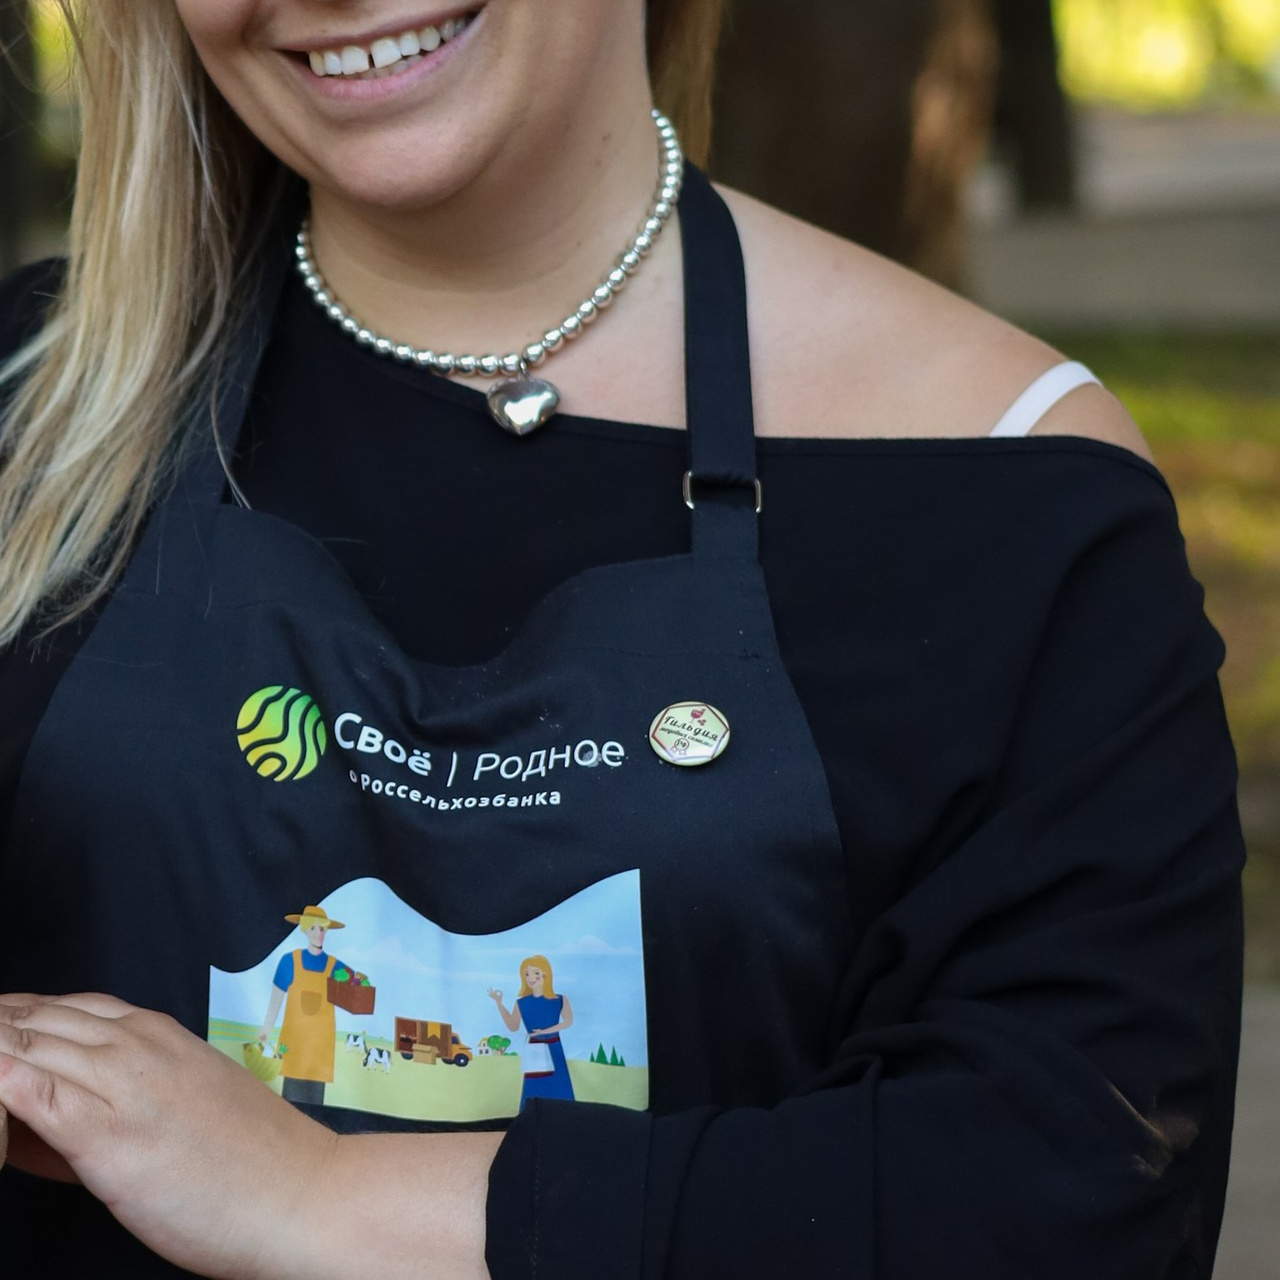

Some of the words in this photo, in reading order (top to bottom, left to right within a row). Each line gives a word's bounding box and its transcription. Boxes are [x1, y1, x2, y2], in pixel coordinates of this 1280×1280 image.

[334, 712, 432, 776] Своё
[473, 739, 625, 781] Родное
[360, 773, 561, 810] Россельхозбанка
